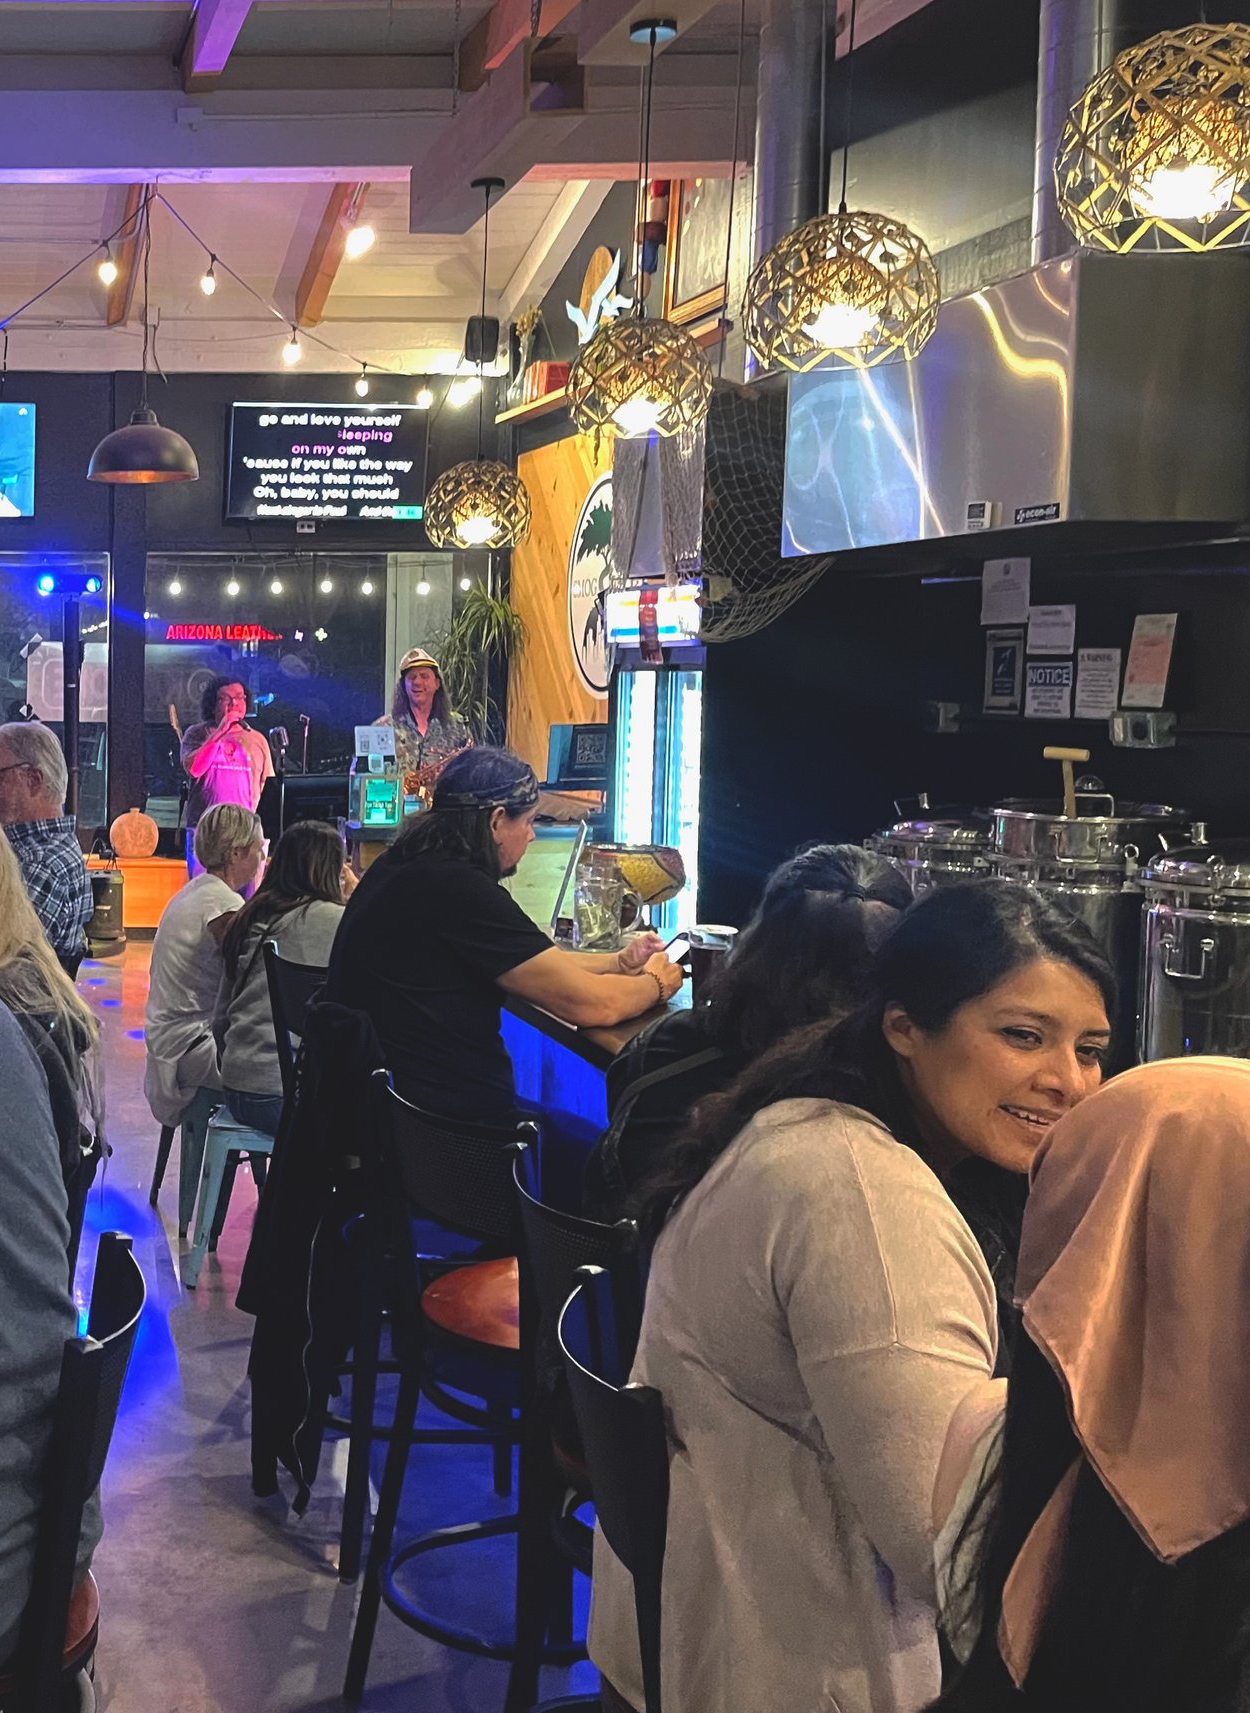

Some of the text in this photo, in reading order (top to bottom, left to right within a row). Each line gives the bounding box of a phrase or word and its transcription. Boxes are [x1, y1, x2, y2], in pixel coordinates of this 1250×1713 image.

[259, 413, 402, 428] go and love yourself
[291, 445, 366, 457] on my own
[303, 459, 330, 471] you
[332, 458, 357, 470] like
[359, 458, 383, 471] the
[385, 460, 413, 473] way
[260, 472, 393, 485] you look that much
[322, 488, 349, 500] you
[351, 487, 399, 500] should
[166, 624, 223, 640] ARIZONA
[1028, 668, 1071, 684] NOTICE
